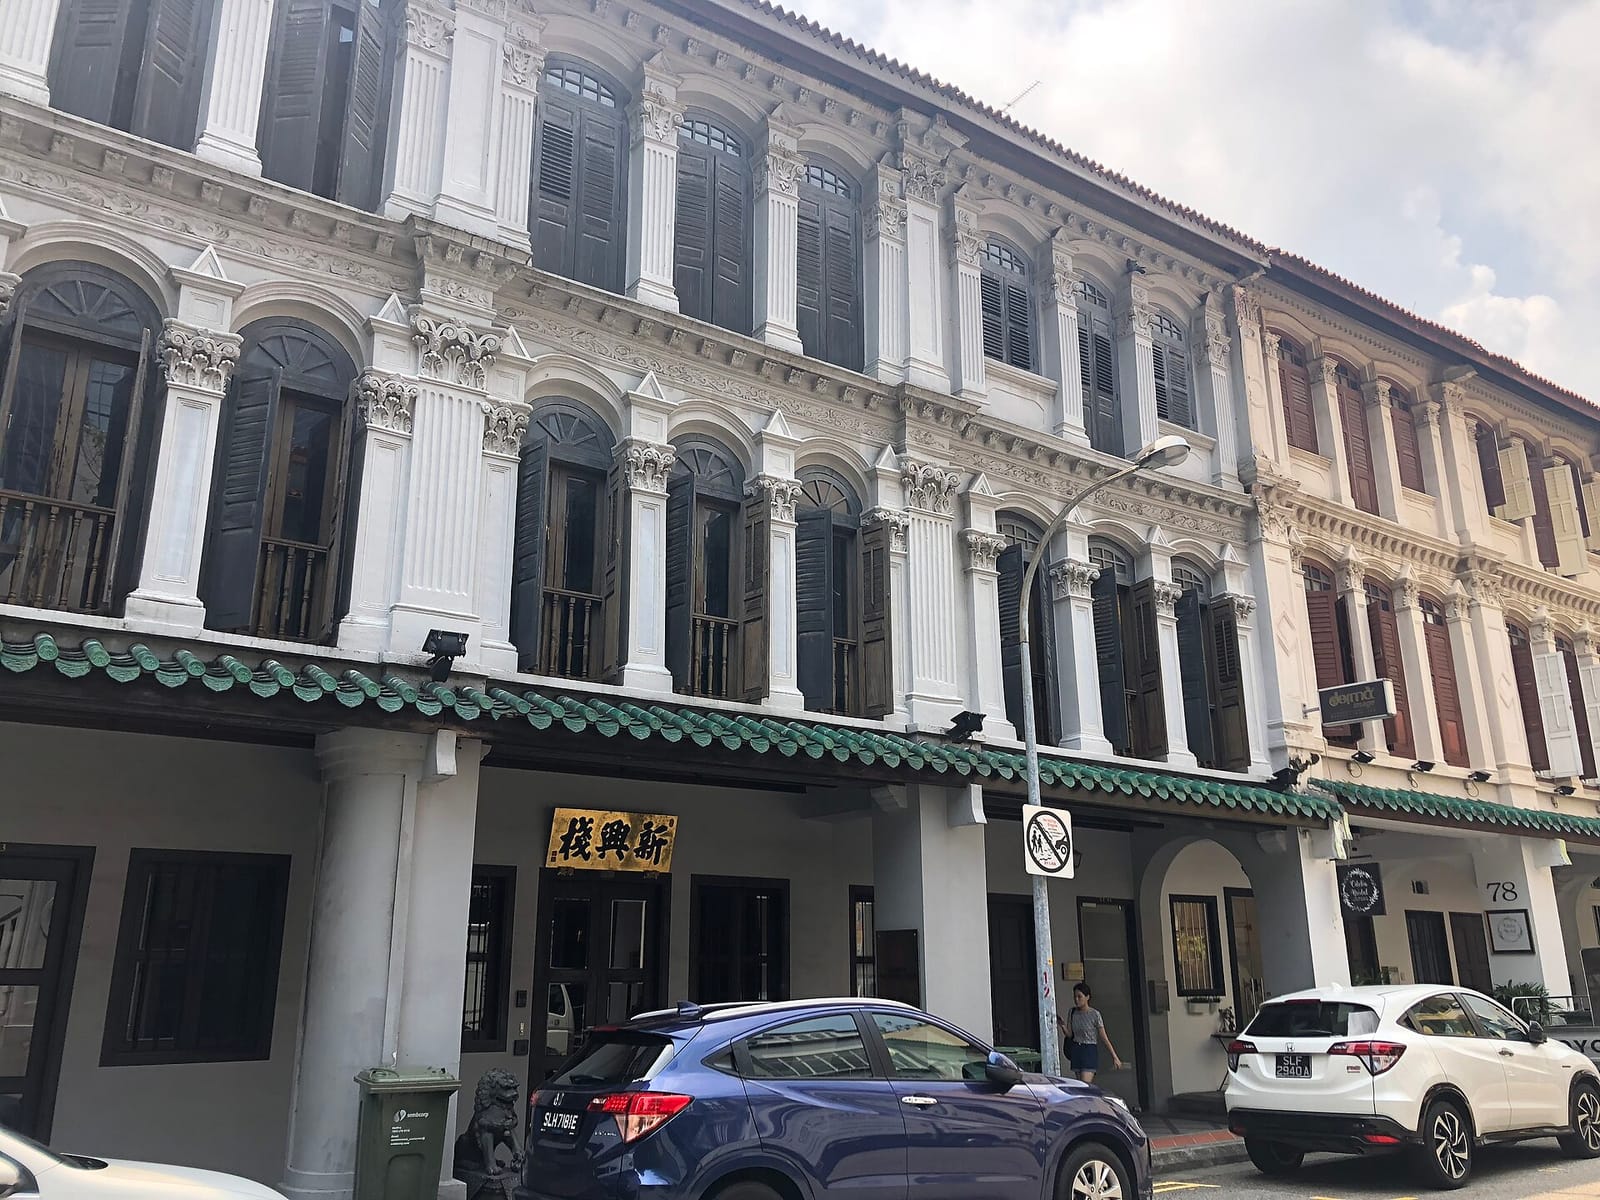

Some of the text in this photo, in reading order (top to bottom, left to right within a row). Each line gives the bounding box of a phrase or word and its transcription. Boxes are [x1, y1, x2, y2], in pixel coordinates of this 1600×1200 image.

[1486, 882, 1518, 902] 78
[1283, 1055, 1303, 1066] SLF
[1276, 1066, 1310, 1077] 2940A
[543, 1112, 579, 1130] SLH7181E
